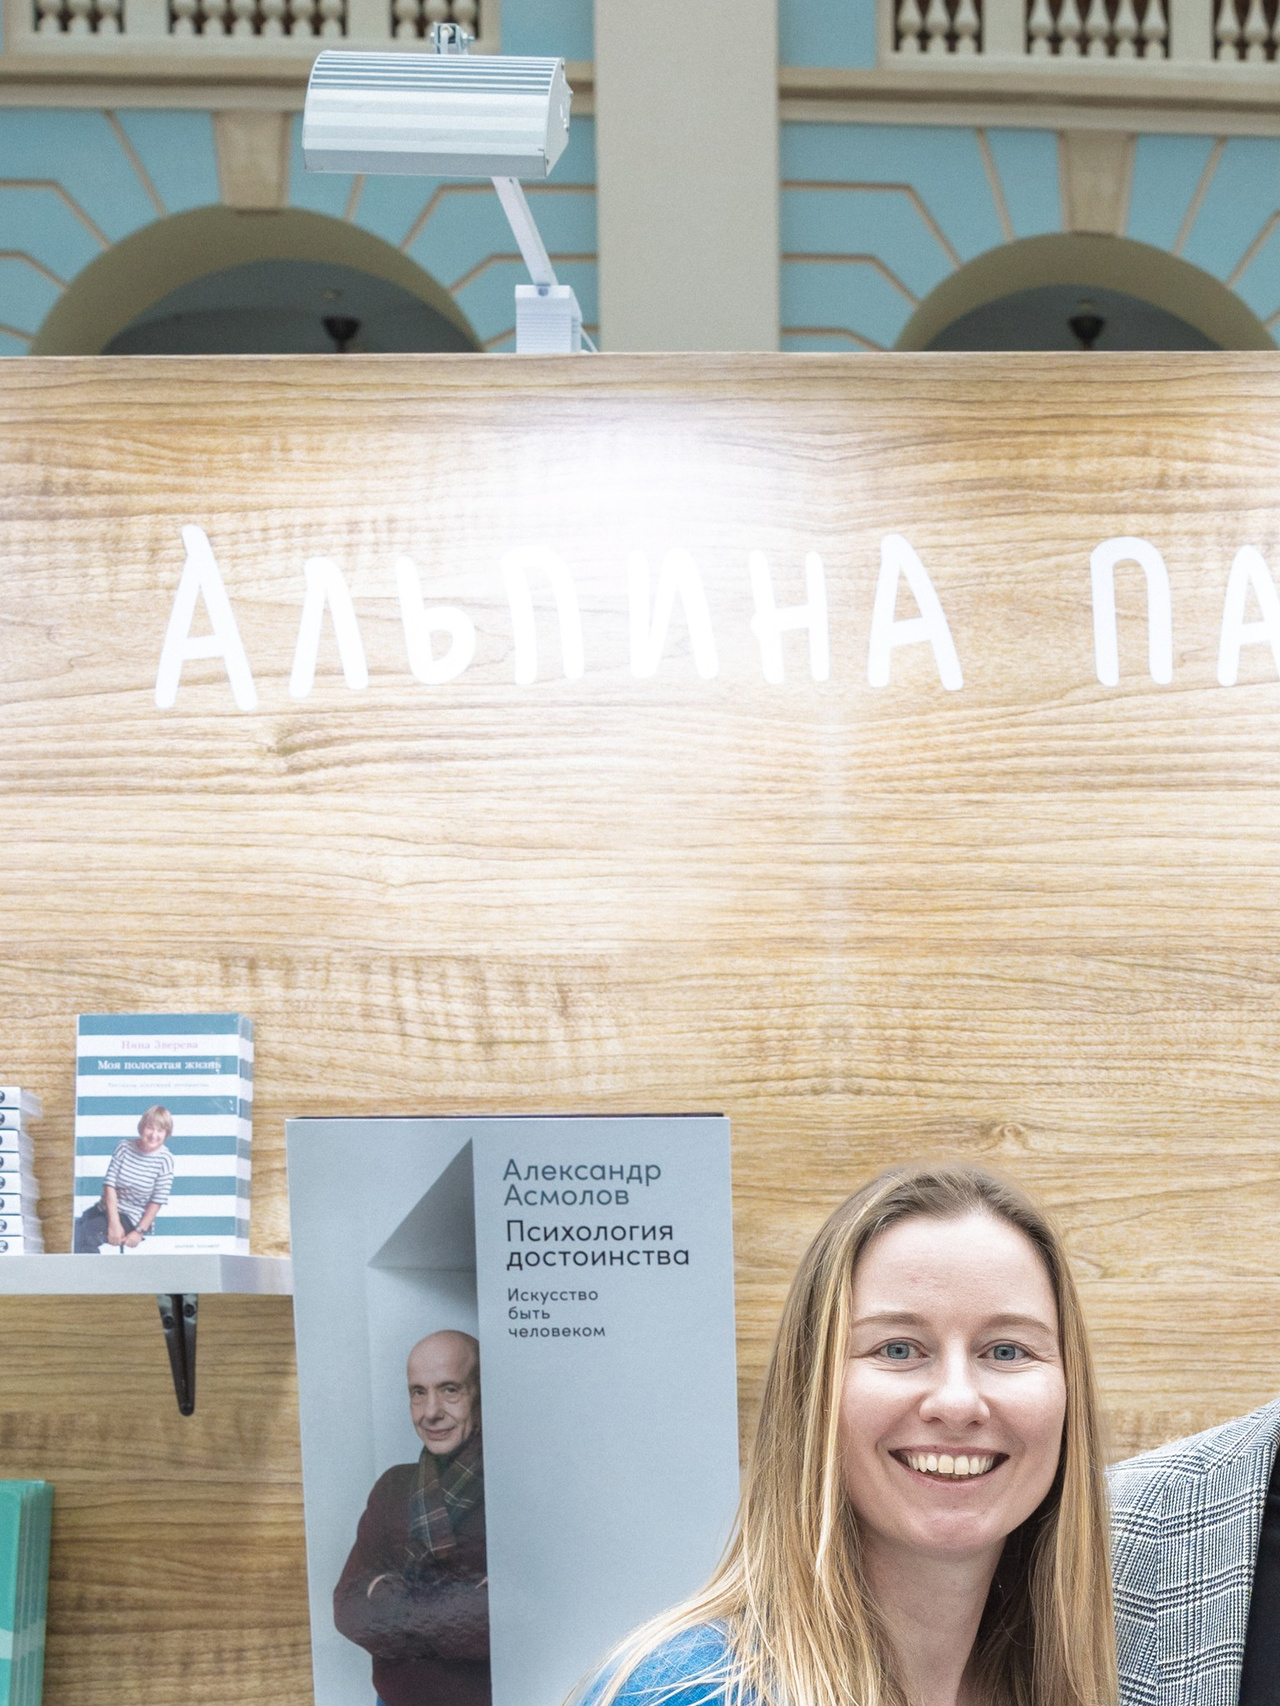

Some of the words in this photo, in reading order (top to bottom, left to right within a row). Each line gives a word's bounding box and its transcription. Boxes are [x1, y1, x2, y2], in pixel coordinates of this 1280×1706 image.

[97, 1060, 121, 1071] Моя
[124, 1061, 182, 1071] полосатая
[502, 1158, 662, 1187] Александр
[504, 1184, 630, 1206] Асмолов
[506, 1219, 674, 1242] Психология
[506, 1249, 690, 1271] достоинства
[507, 1287, 599, 1305] Искусство
[508, 1306, 551, 1320] быть
[508, 1324, 606, 1338] человеком
